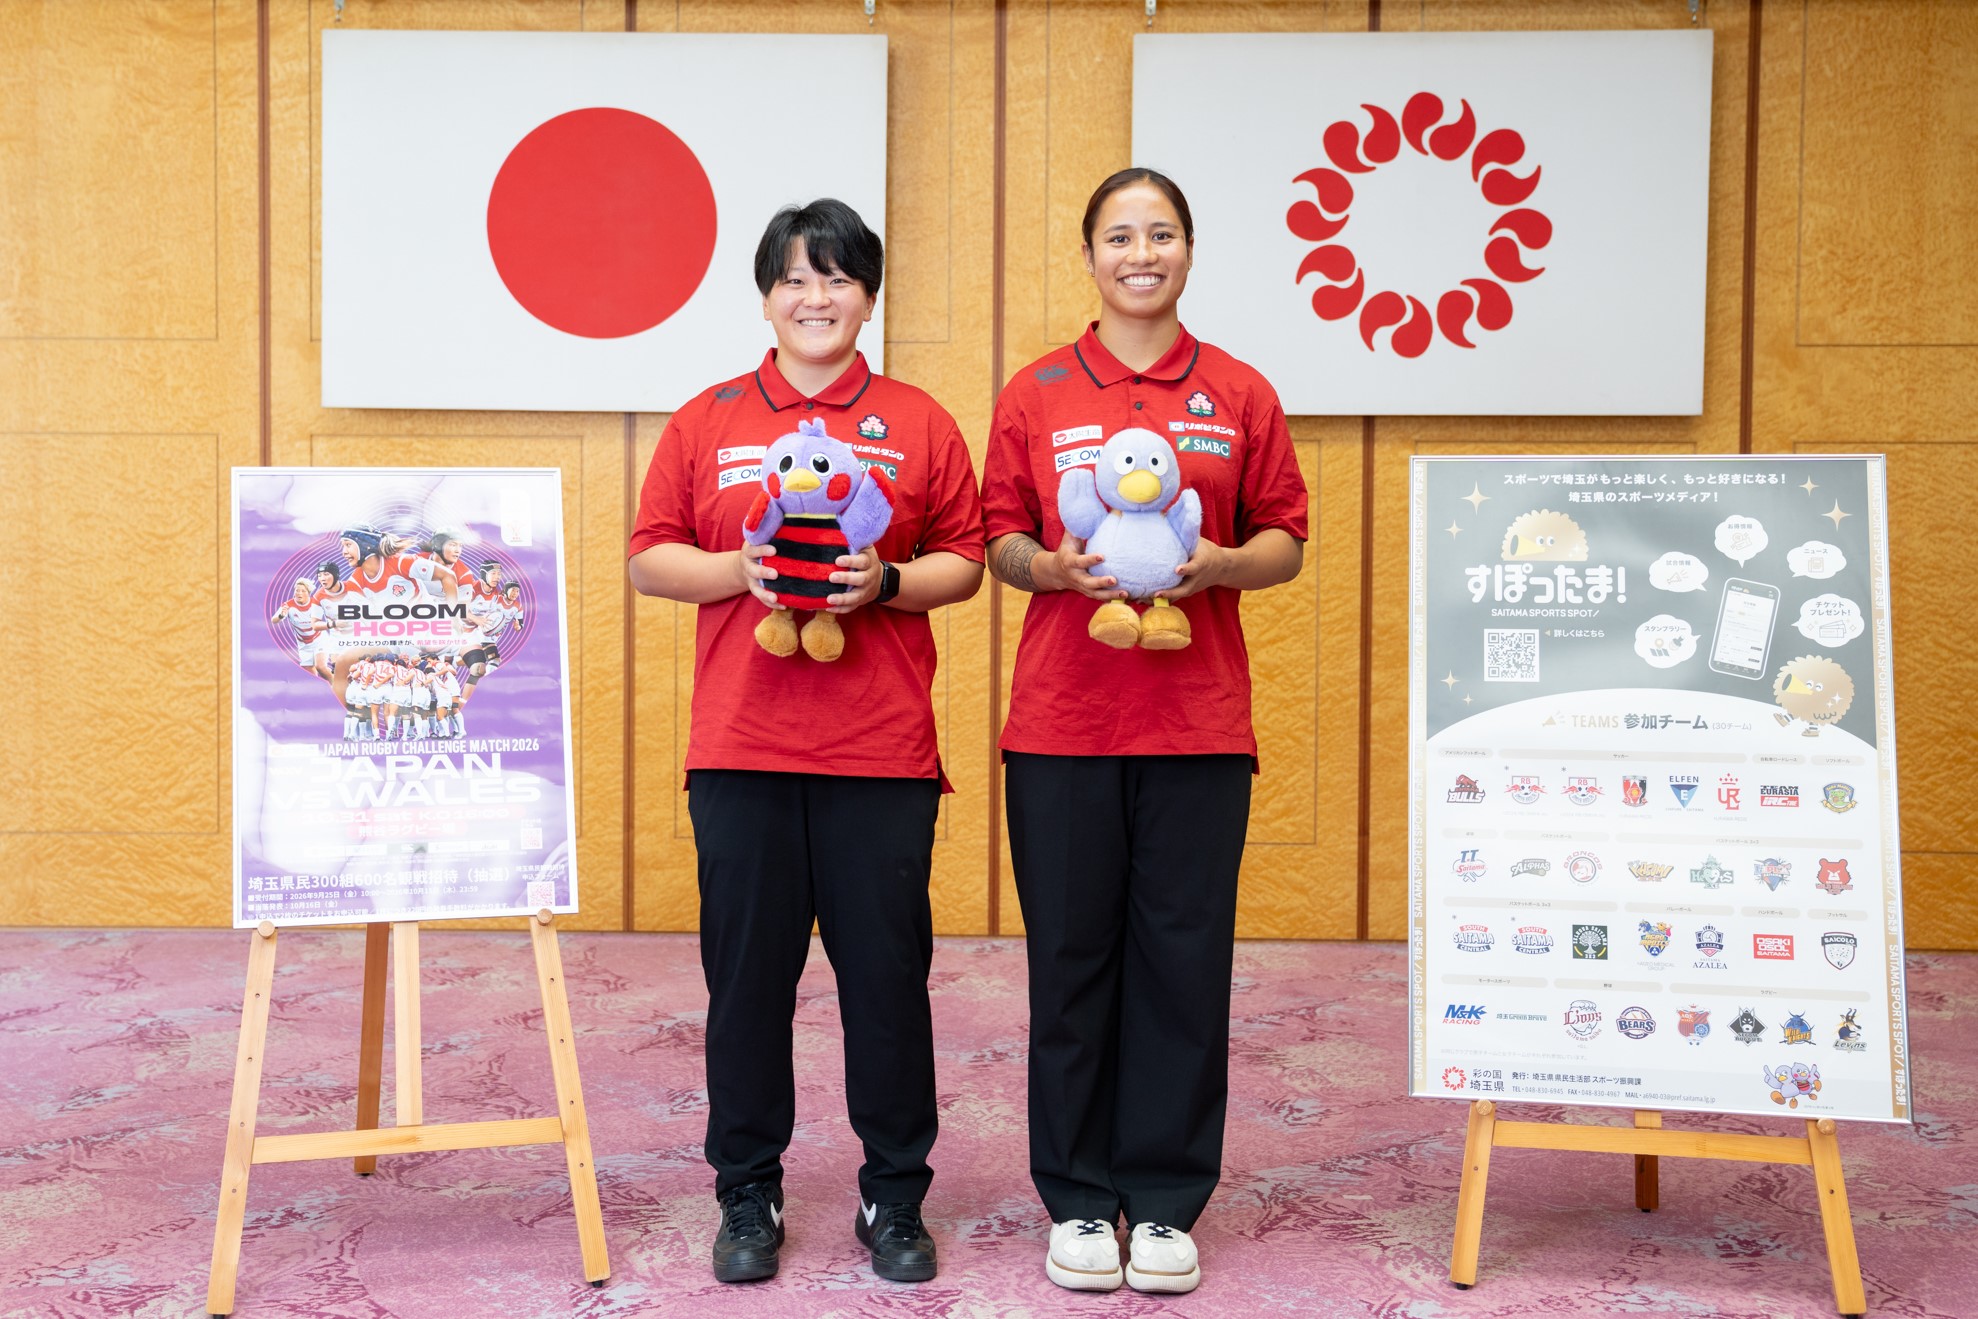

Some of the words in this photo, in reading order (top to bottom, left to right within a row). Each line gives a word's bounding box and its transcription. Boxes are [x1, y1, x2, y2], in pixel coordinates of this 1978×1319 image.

[1193, 438, 1230, 456] SMBC
[1057, 449, 1101, 468] SECOM
[720, 468, 761, 486] SECOM
[1568, 491, 1719, 503] 埼玉県のスポーツメディア！
[1873, 501, 1883, 540] SPORTS
[1415, 530, 1424, 566] SPORTS
[1415, 567, 1424, 606] SAITAMA
[337, 604, 467, 620] BLOOM
[1491, 608, 1528, 617] SAITAMA
[1529, 608, 1566, 617] SPORTS
[353, 621, 452, 637] HOPE
[1554, 629, 1605, 638] 詳しくはこちら
[1876, 618, 1887, 657] SAITAMA
[1877, 658, 1888, 699] SPORTS
[1572, 714, 1619, 728] TEAMS
[1624, 713, 1709, 730] 参加チーム
[322, 743, 359, 758] JAPAN
[361, 742, 399, 756] RUGBY
[402, 740, 467, 755] CHALLENGE
[469, 739, 510, 753] MATCH
[512, 739, 540, 752] 2026
[310, 753, 502, 784] JAPAN
[1669, 775, 1699, 783] ELFEN
[336, 777, 542, 809] WALES
[1449, 791, 1484, 803] BULLS
[1680, 789, 1688, 801] E
[1760, 788, 1799, 796] EURASIA
[1414, 837, 1424, 877] SPORTS
[1563, 850, 1604, 871] BRONCOS
[1456, 863, 1488, 874] Saitama
[1513, 862, 1551, 875] ALPHAS
[1414, 878, 1424, 917] SAITAMA
[1453, 932, 1495, 945] SAITAMA
[1511, 934, 1554, 947] SAITAMA
[1756, 937, 1791, 946] OSAKI
[1824, 937, 1855, 945] SAICOLO
[1692, 962, 1728, 970] AZALEA
[1889, 944, 1901, 987] SAITAMA
[1444, 1004, 1487, 1020] M&K
[1892, 987, 1903, 1030] SPORTS
[1414, 997, 1424, 1038] SPORTS
[1442, 1018, 1481, 1026] RACING
[1563, 1010, 1602, 1026] Lions
[1618, 1019, 1655, 1031] BEARS
[1414, 1039, 1424, 1080] SAITAMA
[1472, 1068, 1502, 1080] 彩の国
[1469, 1080, 1505, 1092] 埼玉県
